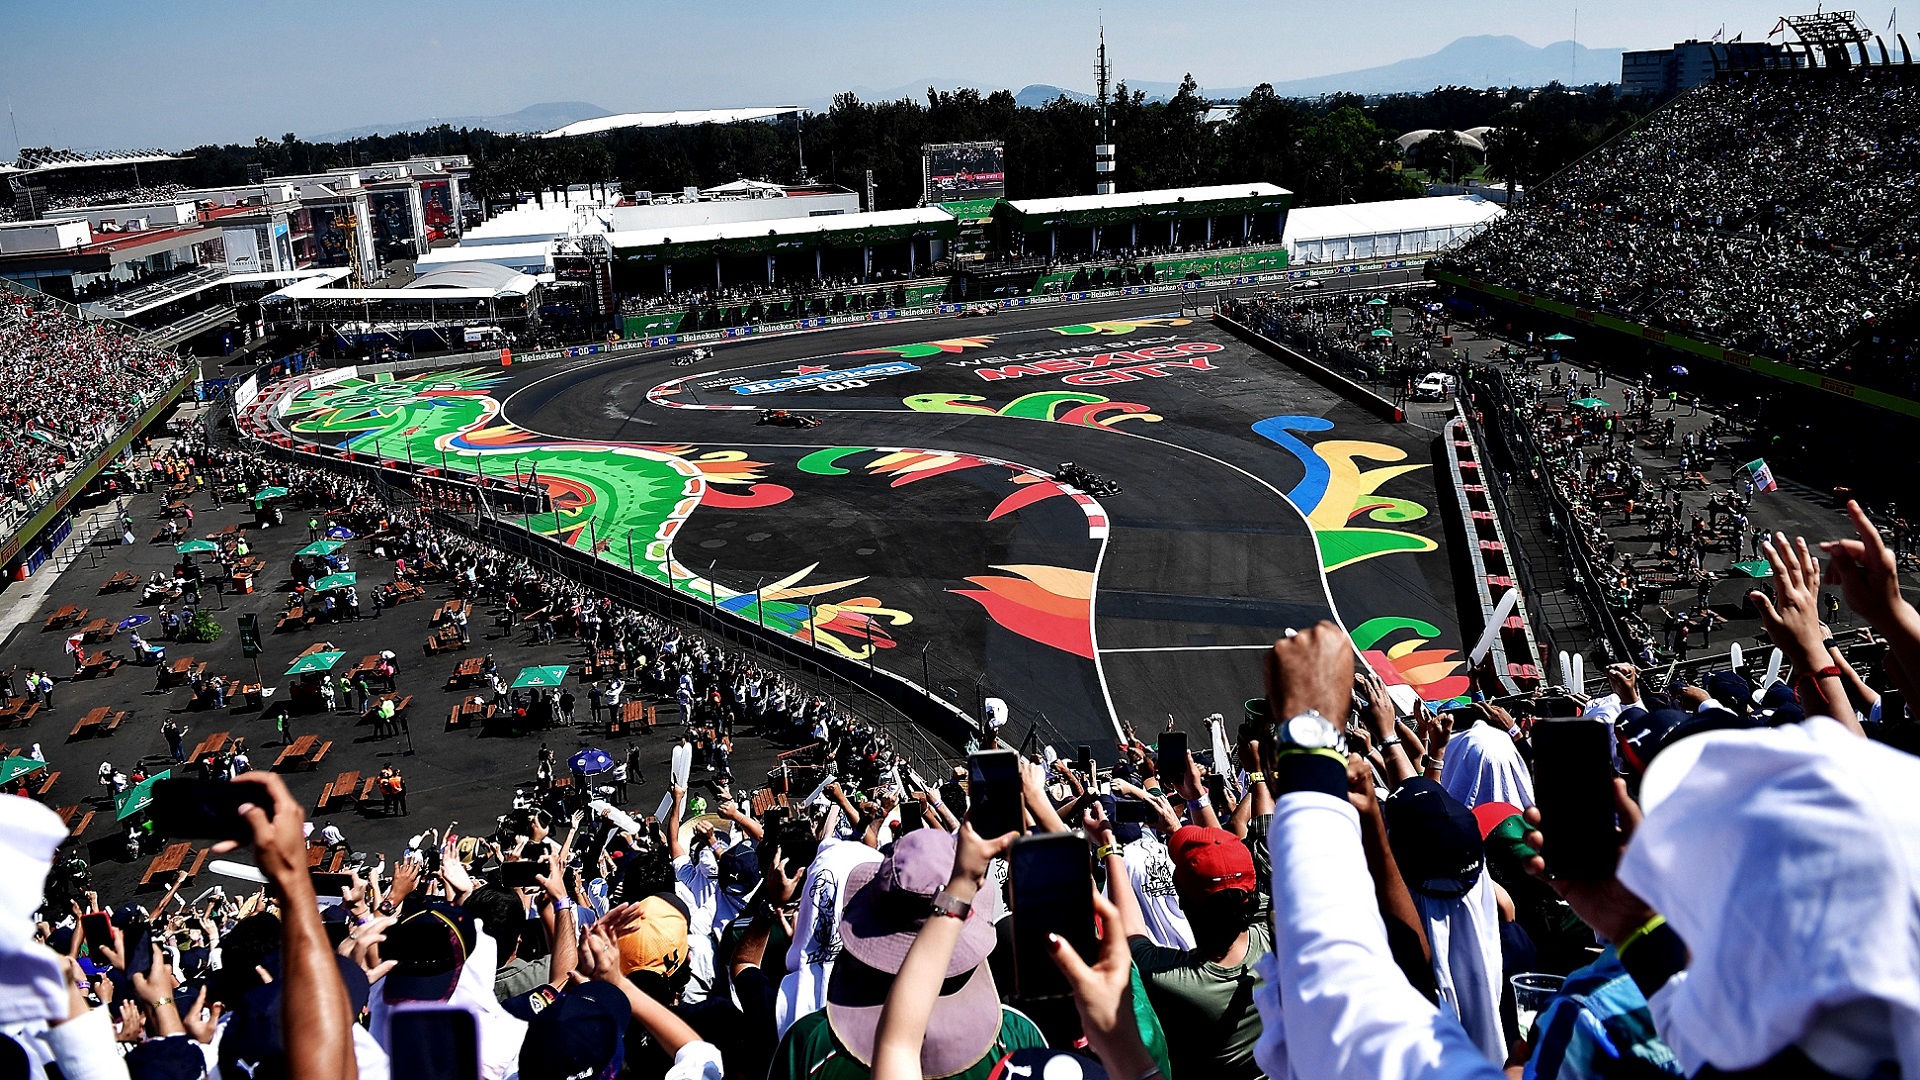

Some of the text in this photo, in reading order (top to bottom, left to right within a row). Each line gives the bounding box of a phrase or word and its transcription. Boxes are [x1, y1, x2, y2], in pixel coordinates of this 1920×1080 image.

[900, 308, 933, 317] Heineken
[831, 315, 865, 324] Heineken
[759, 324, 794, 333] Heineken
[683, 332, 720, 342] Heineken
[946, 335, 1189, 366] WELCOME BACK
[521, 351, 562, 363] Heineken
[974, 342, 1225, 381] MEXICO
[1061, 356, 1220, 386] CITY
[745, 366, 904, 392] Heineken
